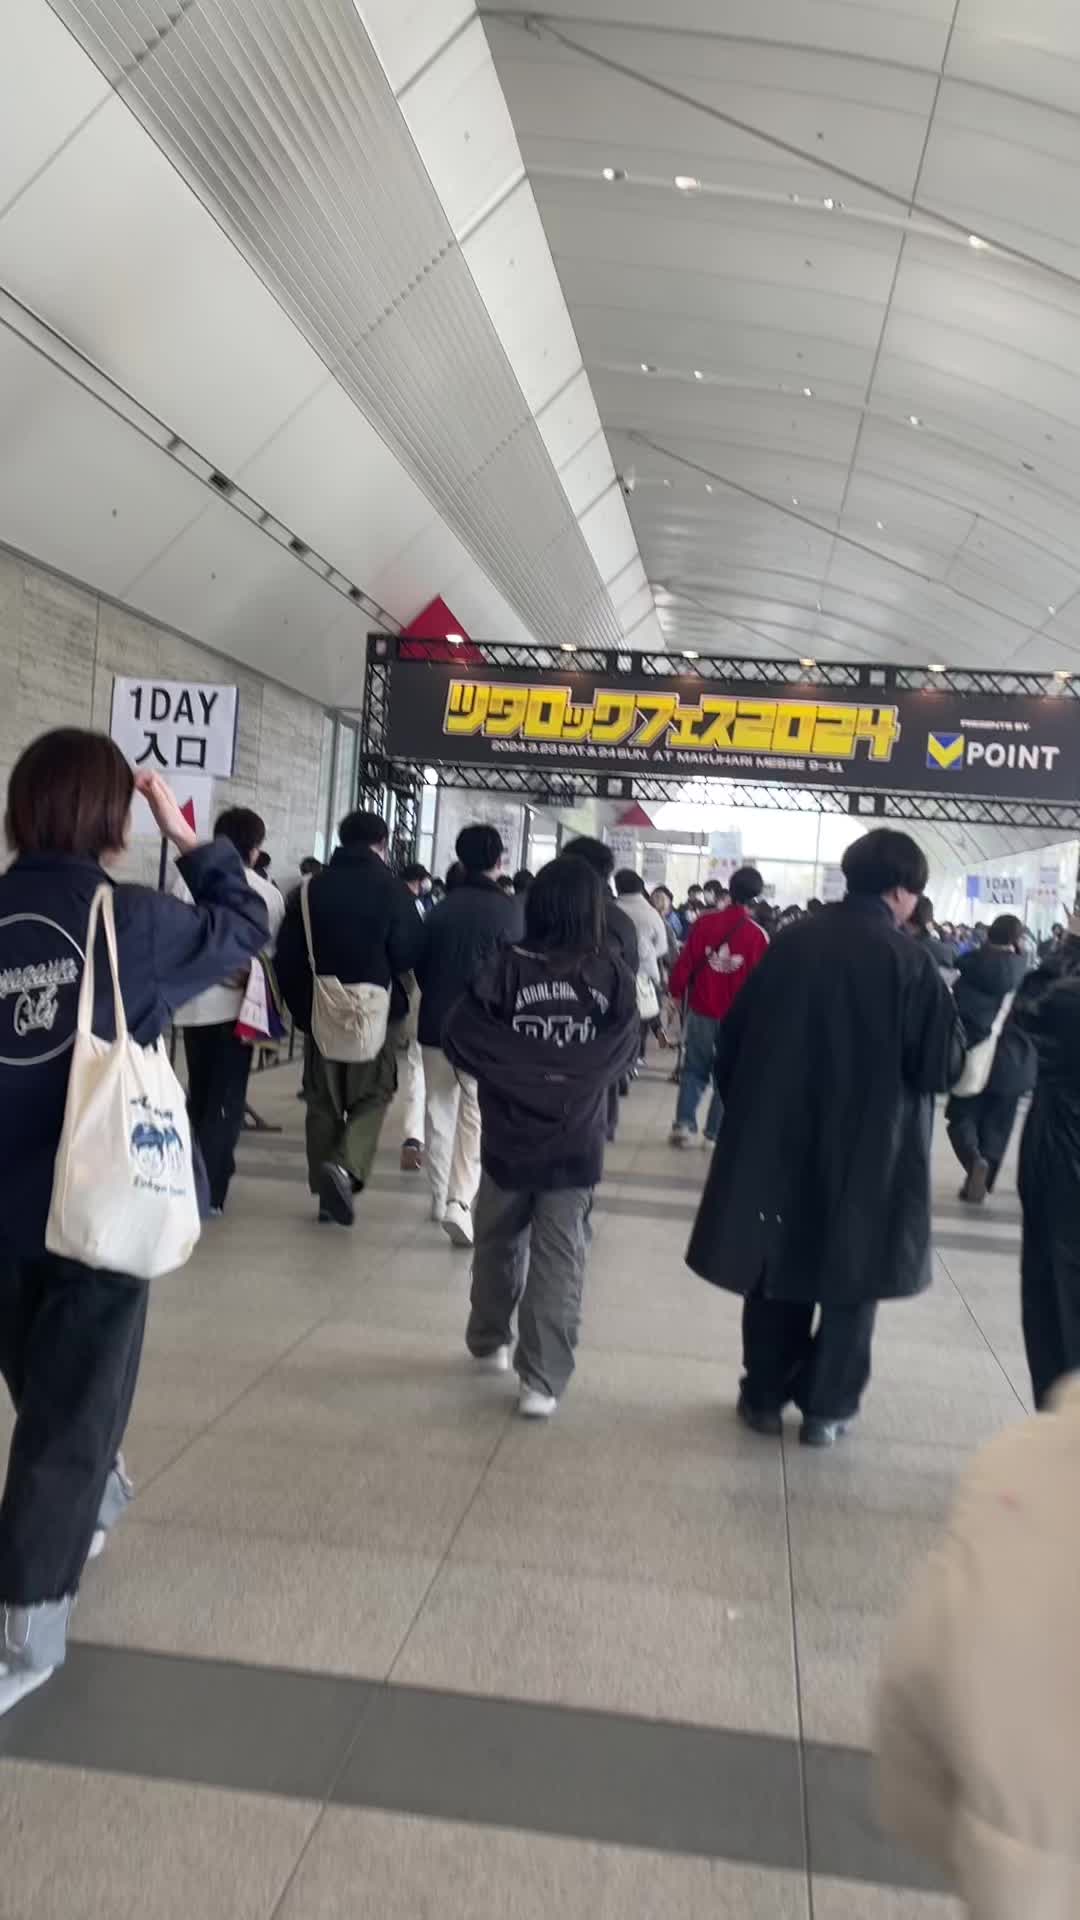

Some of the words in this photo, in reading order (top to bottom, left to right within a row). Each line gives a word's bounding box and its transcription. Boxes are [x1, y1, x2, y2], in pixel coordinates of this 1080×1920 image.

[130, 685, 218, 726] 1DAY
[135, 731, 207, 769] 入口
[653, 750, 673, 762] AT
[677, 752, 753, 767] MAKUHARI
[967, 741, 1060, 770] POINT
